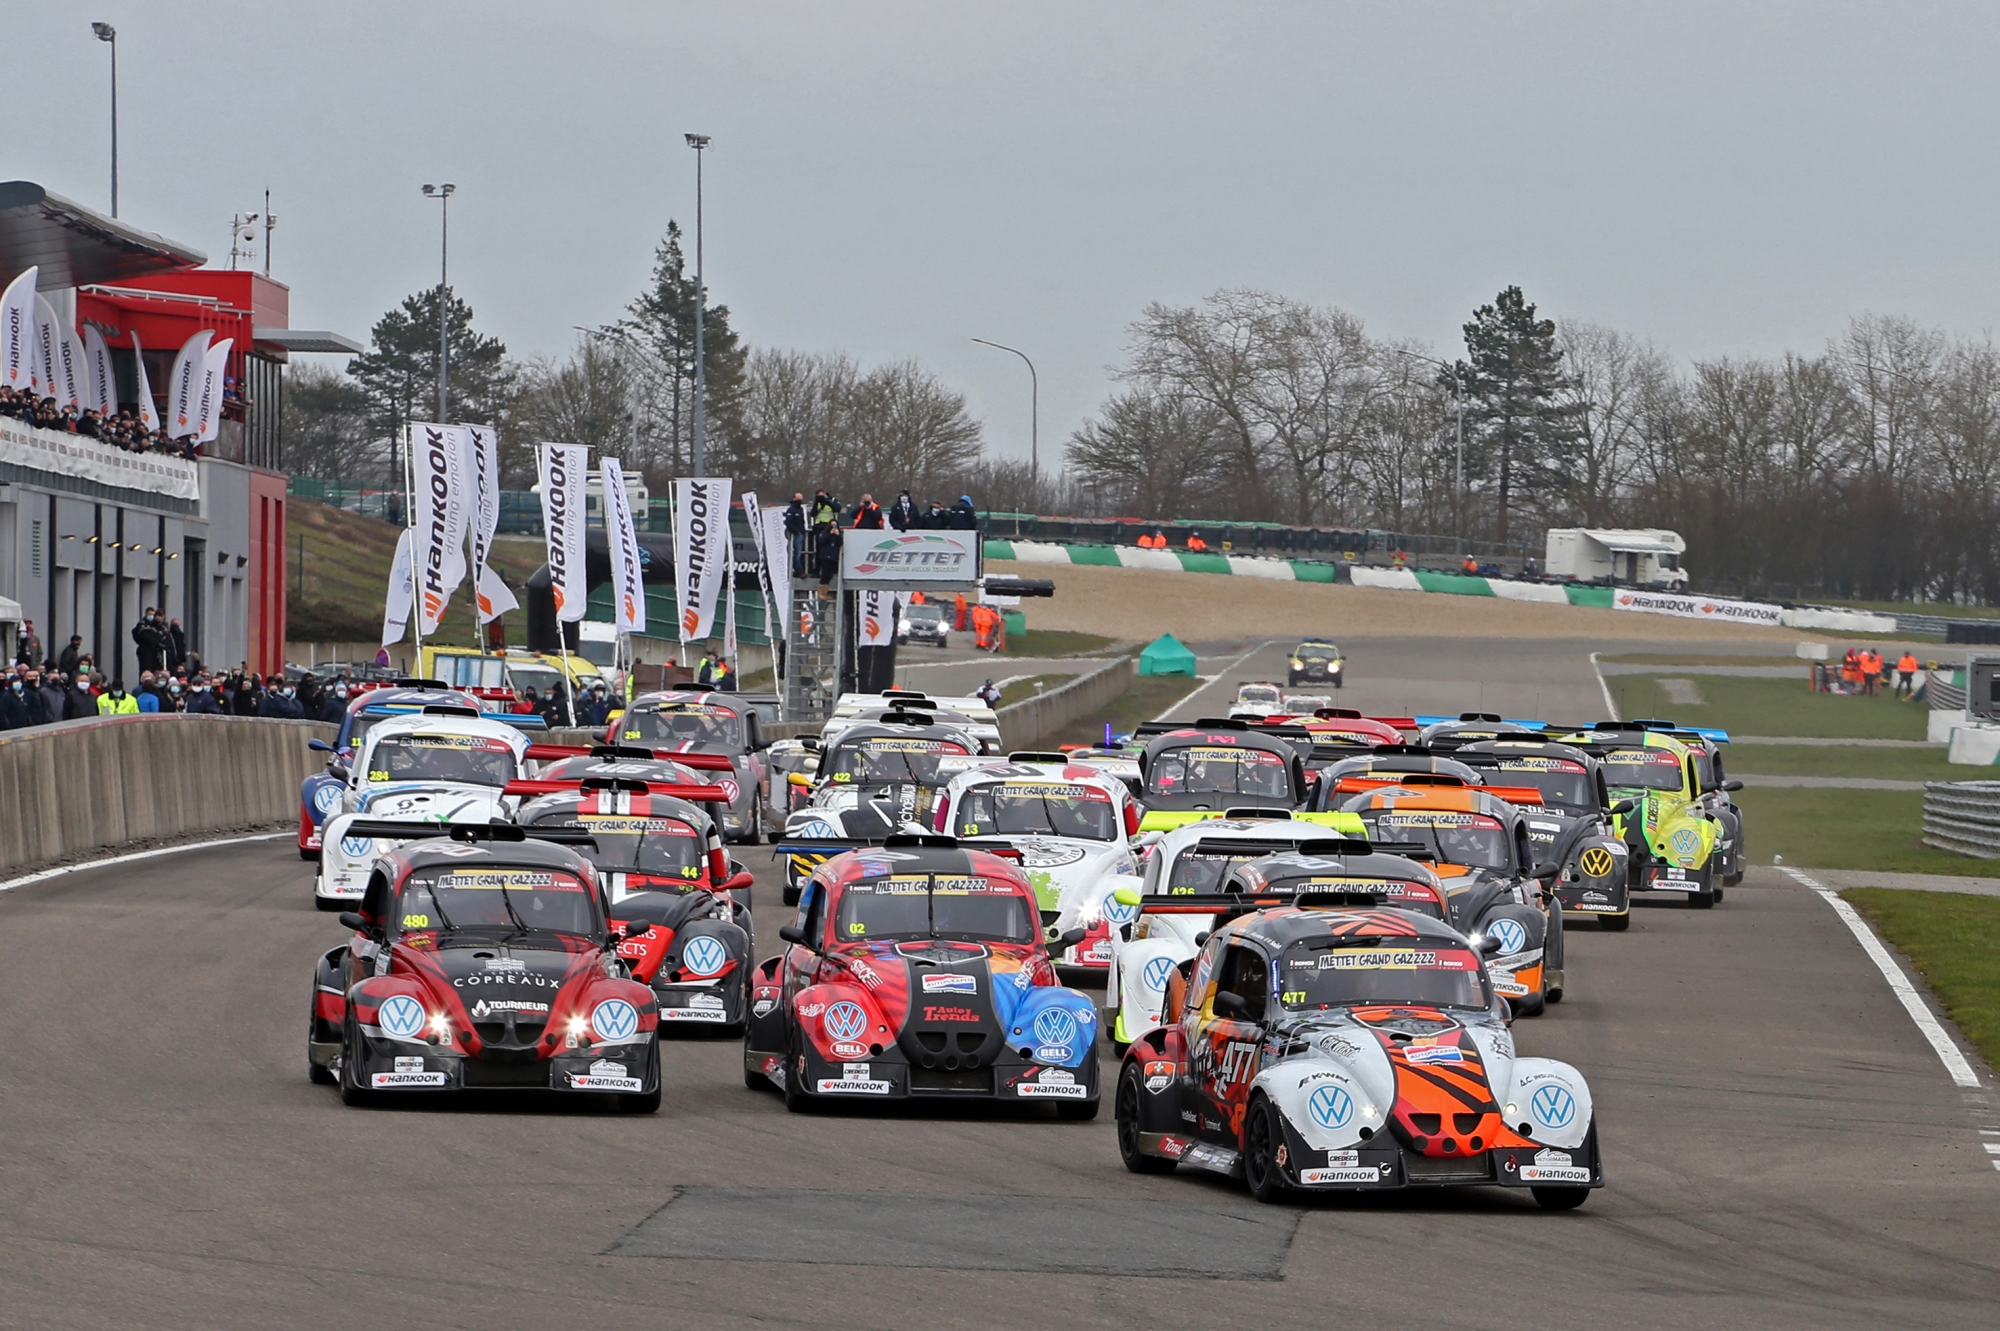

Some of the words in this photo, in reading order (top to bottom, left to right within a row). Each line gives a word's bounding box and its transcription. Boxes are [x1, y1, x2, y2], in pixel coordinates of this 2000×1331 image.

[179, 359, 192, 415] HANKOOK
[200, 369, 214, 423] HANKOOK
[446, 431, 460, 499] emotion
[568, 449, 578, 507] emotion
[425, 425, 449, 594] HANKOOK
[710, 482, 721, 537] emotion
[549, 444, 567, 588] HANKOOK
[444, 500, 461, 556] driving
[566, 511, 578, 556] driving
[608, 464, 635, 595] HANKOOK
[687, 481, 708, 608] HANKOOK
[865, 551, 966, 565] METTET
[1632, 597, 1696, 614] HANKOOK
[1714, 604, 1780, 621] HANKOOK
[832, 773, 851, 782] 422
[991, 786, 1023, 797] METTET
[1050, 786, 1085, 797] GAZZZZ
[598, 820, 628, 832] GRAND
[628, 820, 667, 832] GAZZZZ
[1378, 815, 1411, 826] METTET
[1411, 815, 1438, 825] GRAND
[1438, 815, 1474, 825] GAZZZZ
[963, 824, 979, 835] 13
[681, 866, 699, 879] 44
[437, 874, 474, 888] METTET
[476, 874, 510, 887] GRAND
[510, 873, 553, 887] GAZZZZ
[875, 881, 912, 895] METTET
[913, 880, 945, 893] GRND
[946, 878, 988, 892] GAZZZZ
[1365, 883, 1406, 895] GAZZZZ
[1582, 903, 1618, 912] HANKOOK
[403, 914, 429, 928] 480
[849, 923, 866, 934] 02
[1317, 954, 1358, 970] METTET
[1358, 953, 1392, 967] GRAND
[1393, 951, 1437, 967] GAZZZZ
[453, 974, 560, 989] COPREAUX
[926, 977, 974, 988] AUTOGRAPHE
[1492, 983, 1526, 993] ANKOOK
[1282, 991, 1307, 1003] 477
[488, 1000, 549, 1012] TOURNEUR
[937, 1006, 965, 1014] Auto
[677, 1011, 723, 1020] HANKOOK
[923, 1006, 980, 1022] Trends
[835, 1044, 863, 1053] BELL
[1040, 1048, 1068, 1058] BELL
[1410, 1047, 1460, 1059] AUTOGRAPHE
[1221, 1041, 1257, 1085] 477
[387, 1074, 440, 1083] HANKOOK
[586, 1077, 637, 1088] HANKOOK
[832, 1081, 884, 1091] HANKOOK
[1033, 1084, 1082, 1095] HANKOOK
[1165, 1137, 1185, 1155] TOTAL
[1319, 1171, 1376, 1181] HANKOOK
[1538, 1169, 1588, 1180] HANKOOK
